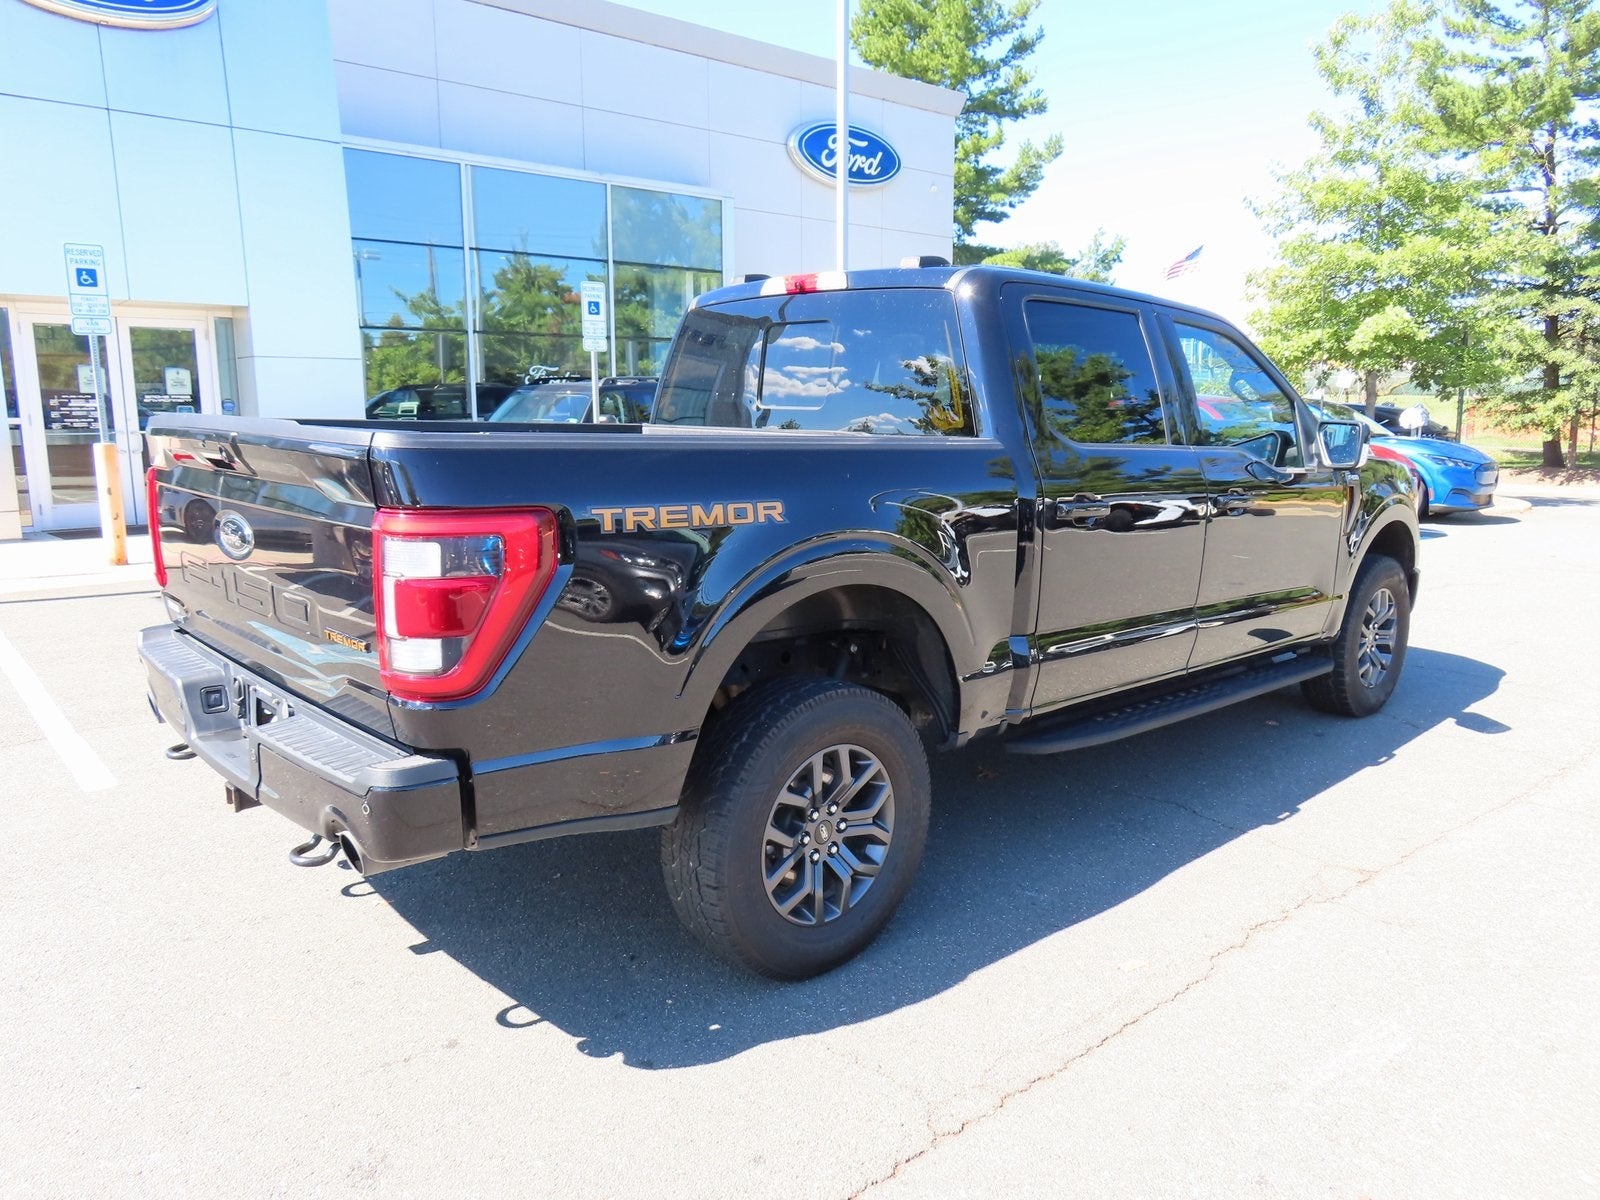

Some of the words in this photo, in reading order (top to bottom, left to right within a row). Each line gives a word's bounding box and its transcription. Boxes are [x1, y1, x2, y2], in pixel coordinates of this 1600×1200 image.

[69, 258, 100, 266] PARKING
[590, 501, 787, 533] TREMOR
[324, 629, 368, 652] TREMOR
